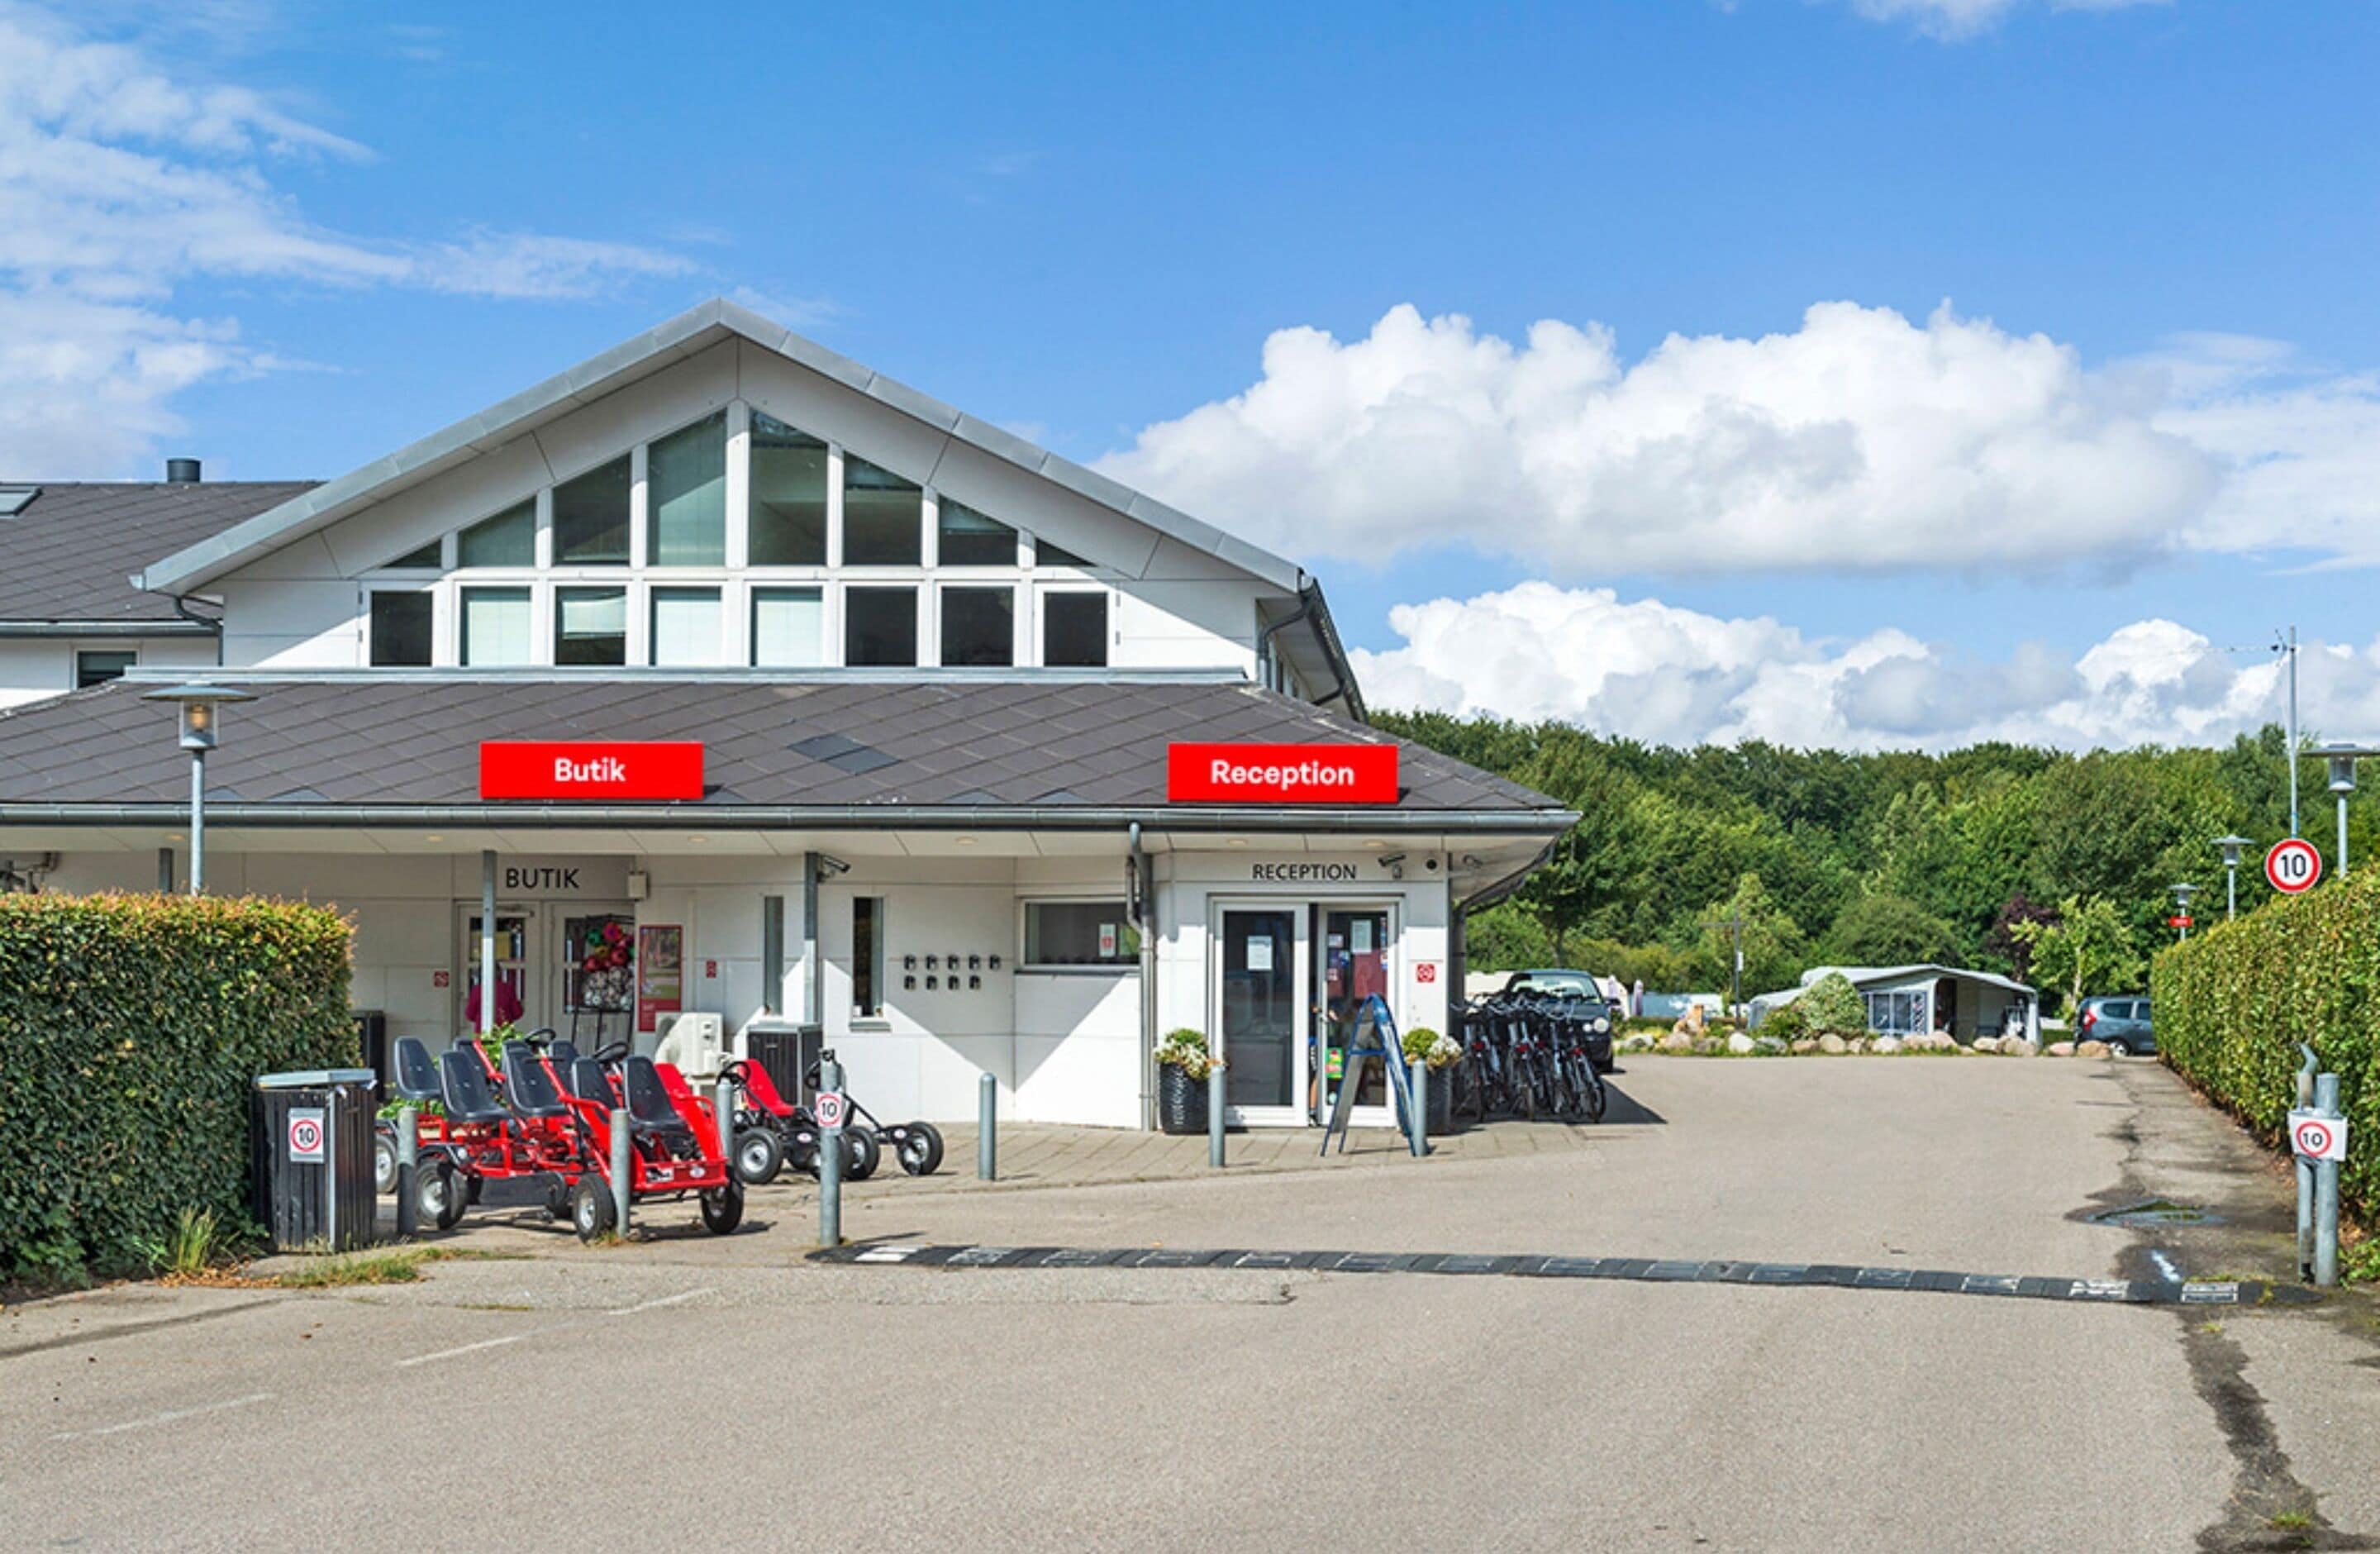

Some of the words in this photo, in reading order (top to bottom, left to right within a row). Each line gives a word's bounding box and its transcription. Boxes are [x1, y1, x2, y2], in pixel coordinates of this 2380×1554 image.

[555, 757, 626, 783] Butik
[1211, 760, 1355, 791] Reception
[1252, 863, 1357, 881] RECEPTION
[2280, 854, 2307, 878] 10
[506, 868, 580, 889] BUTIK
[822, 1102, 837, 1118] 10
[298, 1127, 315, 1143] 10
[2302, 1132, 2323, 1147] 10
